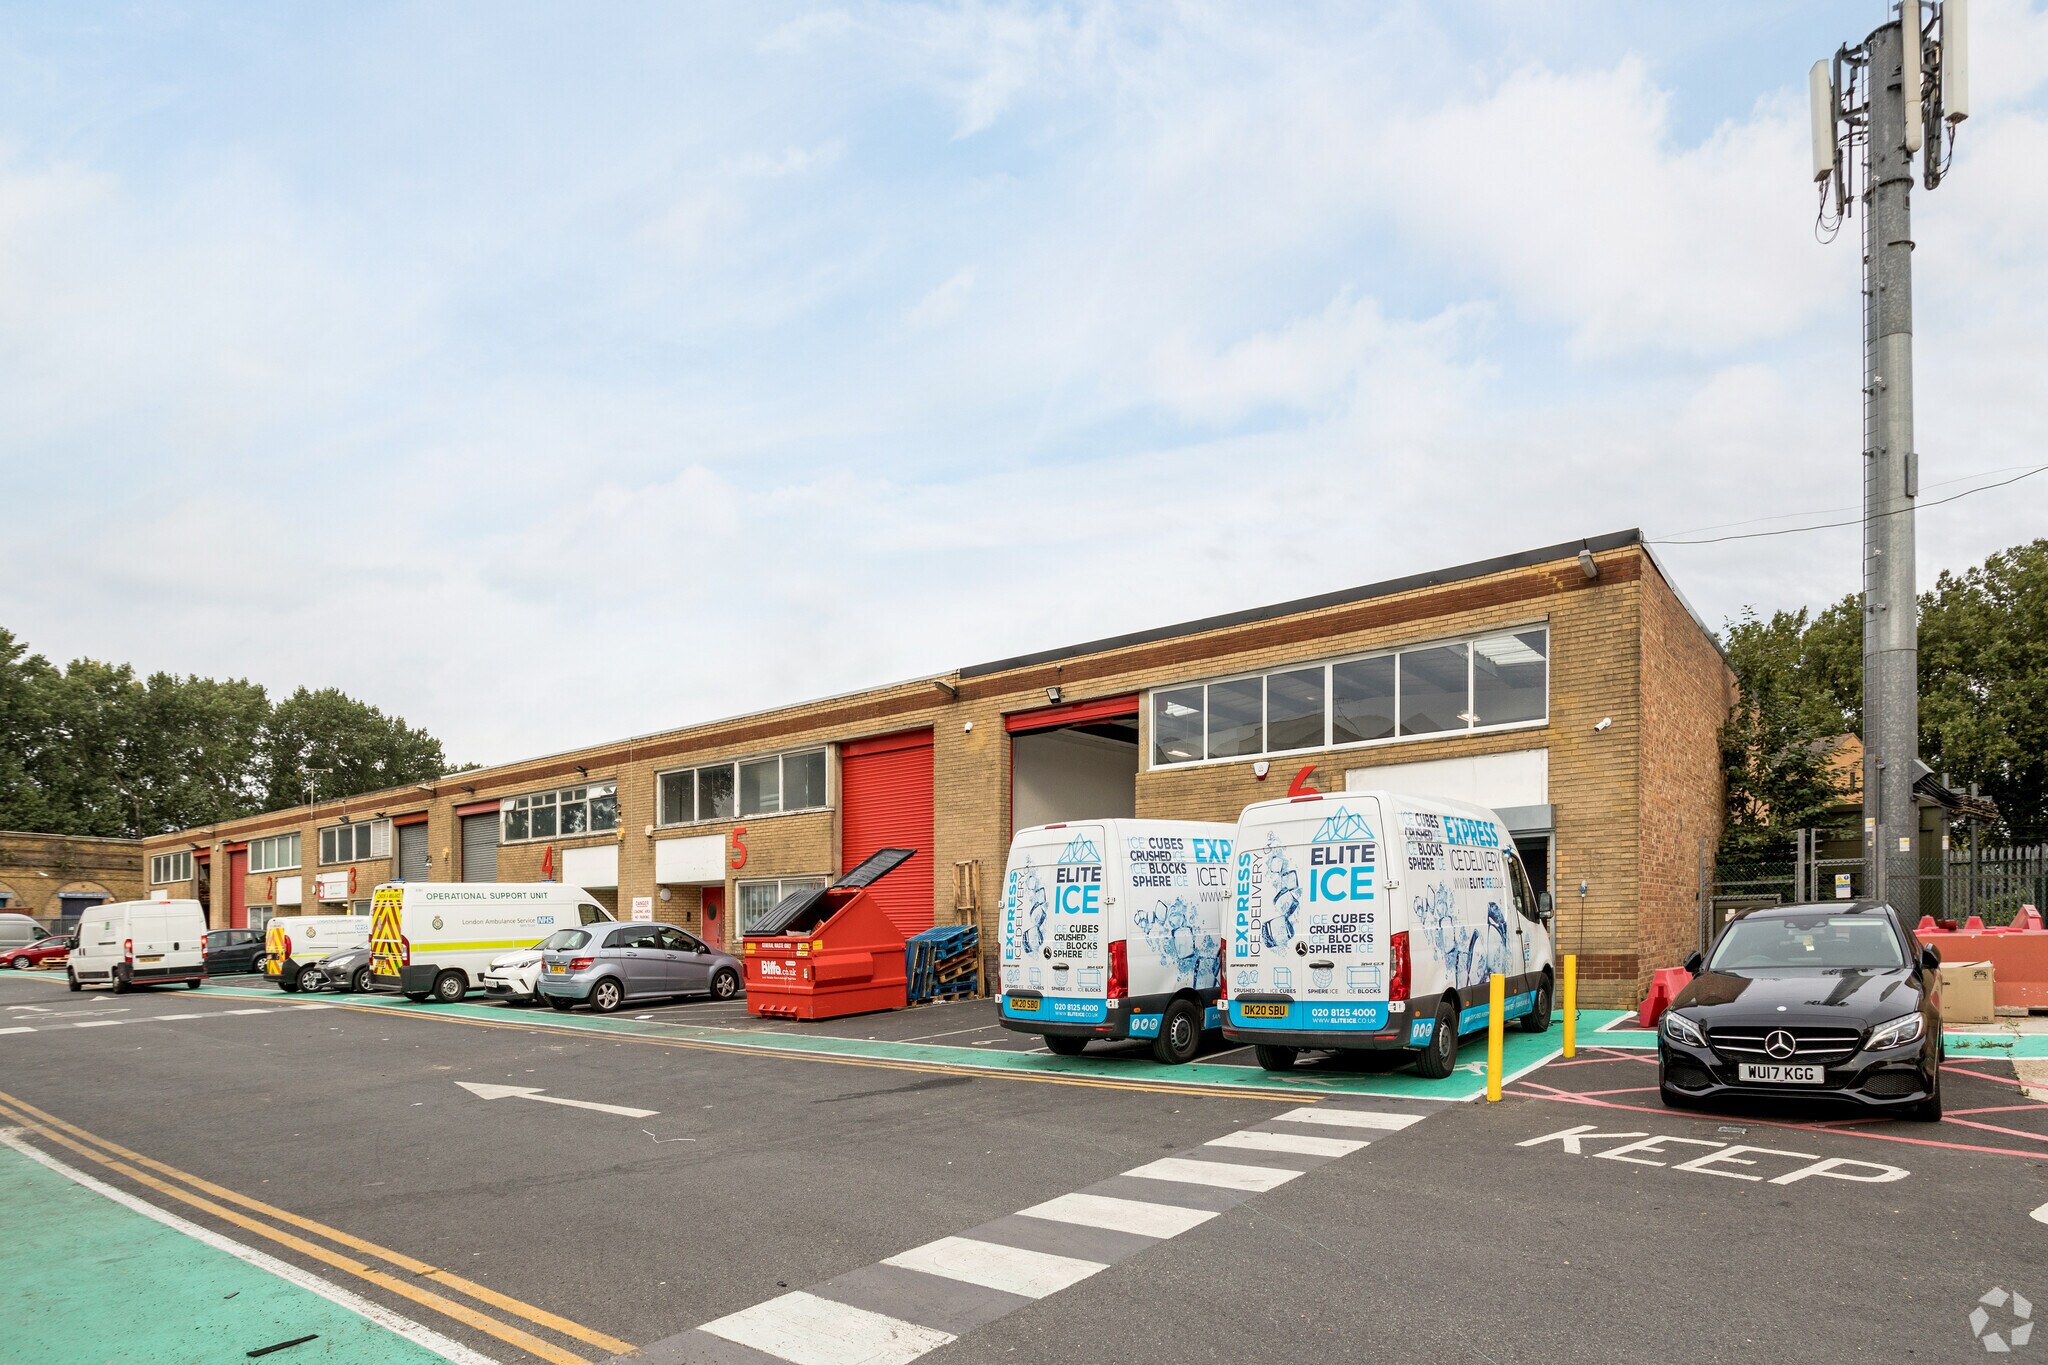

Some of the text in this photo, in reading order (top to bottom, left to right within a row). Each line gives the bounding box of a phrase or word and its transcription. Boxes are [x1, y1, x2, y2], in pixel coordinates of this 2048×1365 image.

[1286, 765, 1319, 797] 6
[1414, 813, 1439, 828] CUBES
[1405, 827, 1432, 840] CRUSHED
[1443, 816, 1498, 847] EXPRESS
[732, 828, 747, 869] 5
[1127, 836, 1184, 850] ICE CUBES
[1192, 838, 1233, 862] EXP
[1418, 842, 1444, 856] BLOCKS
[542, 845, 554, 880] 4
[1130, 850, 1186, 862] CRUSHED ICE
[1311, 844, 1376, 866] ELITE
[1408, 856, 1435, 870] SPHERE
[1449, 849, 1500, 871] ICE DELIVERY
[1056, 866, 1102, 883] ELITE
[1130, 863, 1187, 874] ICE BLOCKS
[1196, 867, 1218, 886] ICE
[266, 876, 272, 900] 2
[350, 866, 356, 894] 3
[1132, 876, 1188, 887] SPHERE ICE
[1310, 866, 1374, 902] ICE
[320, 886, 324, 898] 3
[1055, 884, 1100, 914] ICE
[1016, 872, 1025, 937] DELIVERY
[1236, 853, 1251, 958] EXPRESS
[1250, 854, 1263, 958] ICE DELIVERY
[537, 916, 554, 924] NHS
[1006, 872, 1018, 960] EXPRESS
[1310, 913, 1374, 924] ICE CUBES
[1054, 924, 1099, 933] ICE CUBES
[1310, 924, 1374, 934] CRUSHED ICE
[1309, 934, 1374, 944] ICE BLOCKS
[1309, 944, 1374, 954] SPHERE ICE
[761, 960, 796, 976] Biffa.co.uk
[1012, 999, 1026, 1008] DK20
[1245, 1005, 1285, 1016] DK20 SBU
[1748, 1066, 1814, 1080] WU17 KGG
[1514, 1125, 1910, 1185] KEEP
